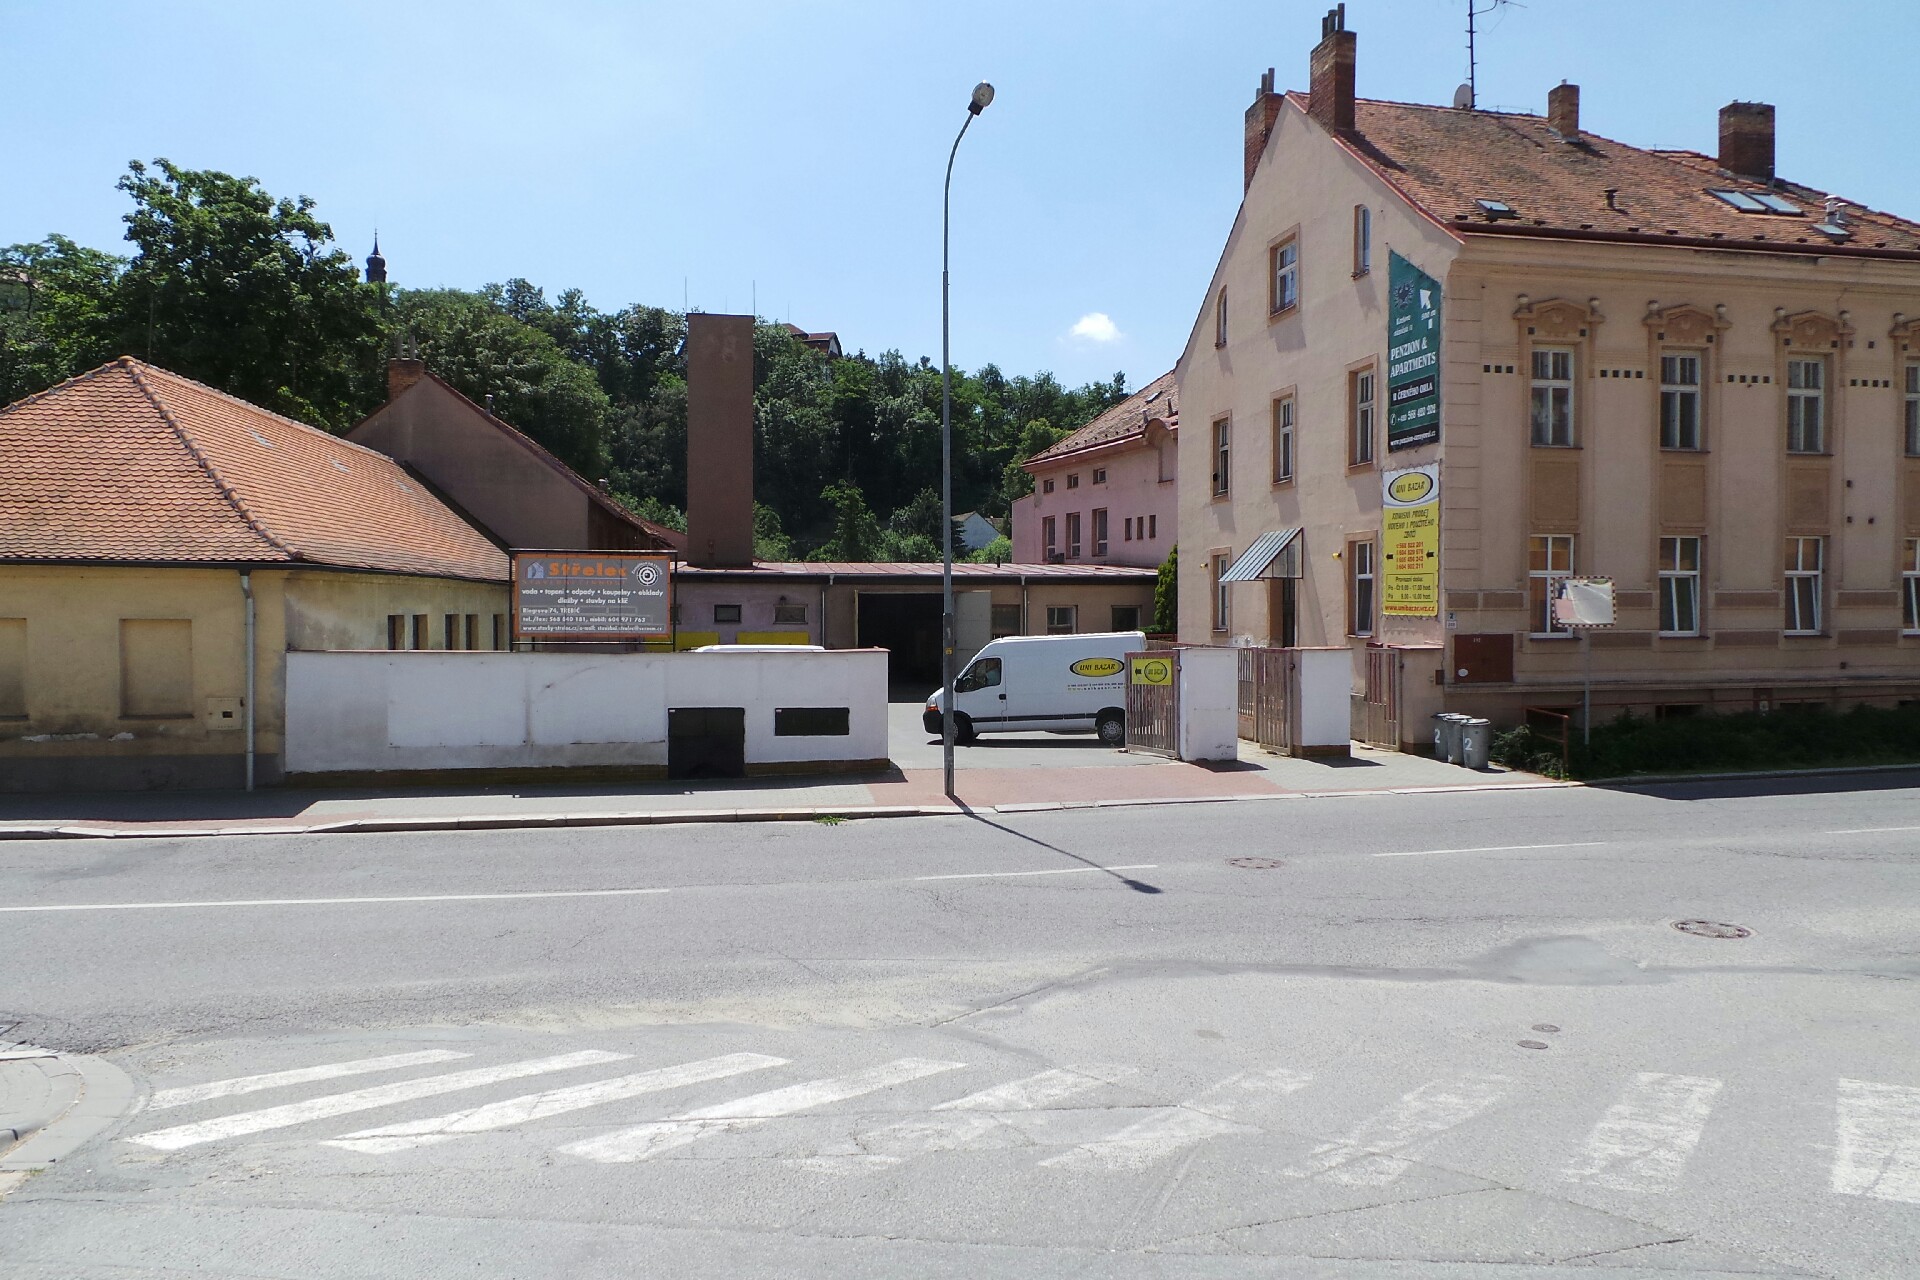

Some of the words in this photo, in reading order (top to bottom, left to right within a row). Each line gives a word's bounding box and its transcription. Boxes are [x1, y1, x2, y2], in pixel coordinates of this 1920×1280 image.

[1390, 339, 1420, 360] PENZION
[1421, 336, 1428, 350] &
[1390, 351, 1436, 378] APARTMENTS
[1420, 382, 1433, 394] ORLA
[1396, 484, 1406, 493] UNI
[1407, 481, 1425, 492] BAZAR
[549, 561, 627, 577] Střelec
[571, 588, 595, 596] odpady
[602, 588, 631, 597] koupelny
[638, 589, 663, 597] obklady
[557, 596, 578, 605] dlažby
[585, 597, 606, 605] stavby
[1094, 663, 1116, 671] BAZAR
[1434, 728, 1440, 744] 2
[1464, 737, 1472, 751] 2
